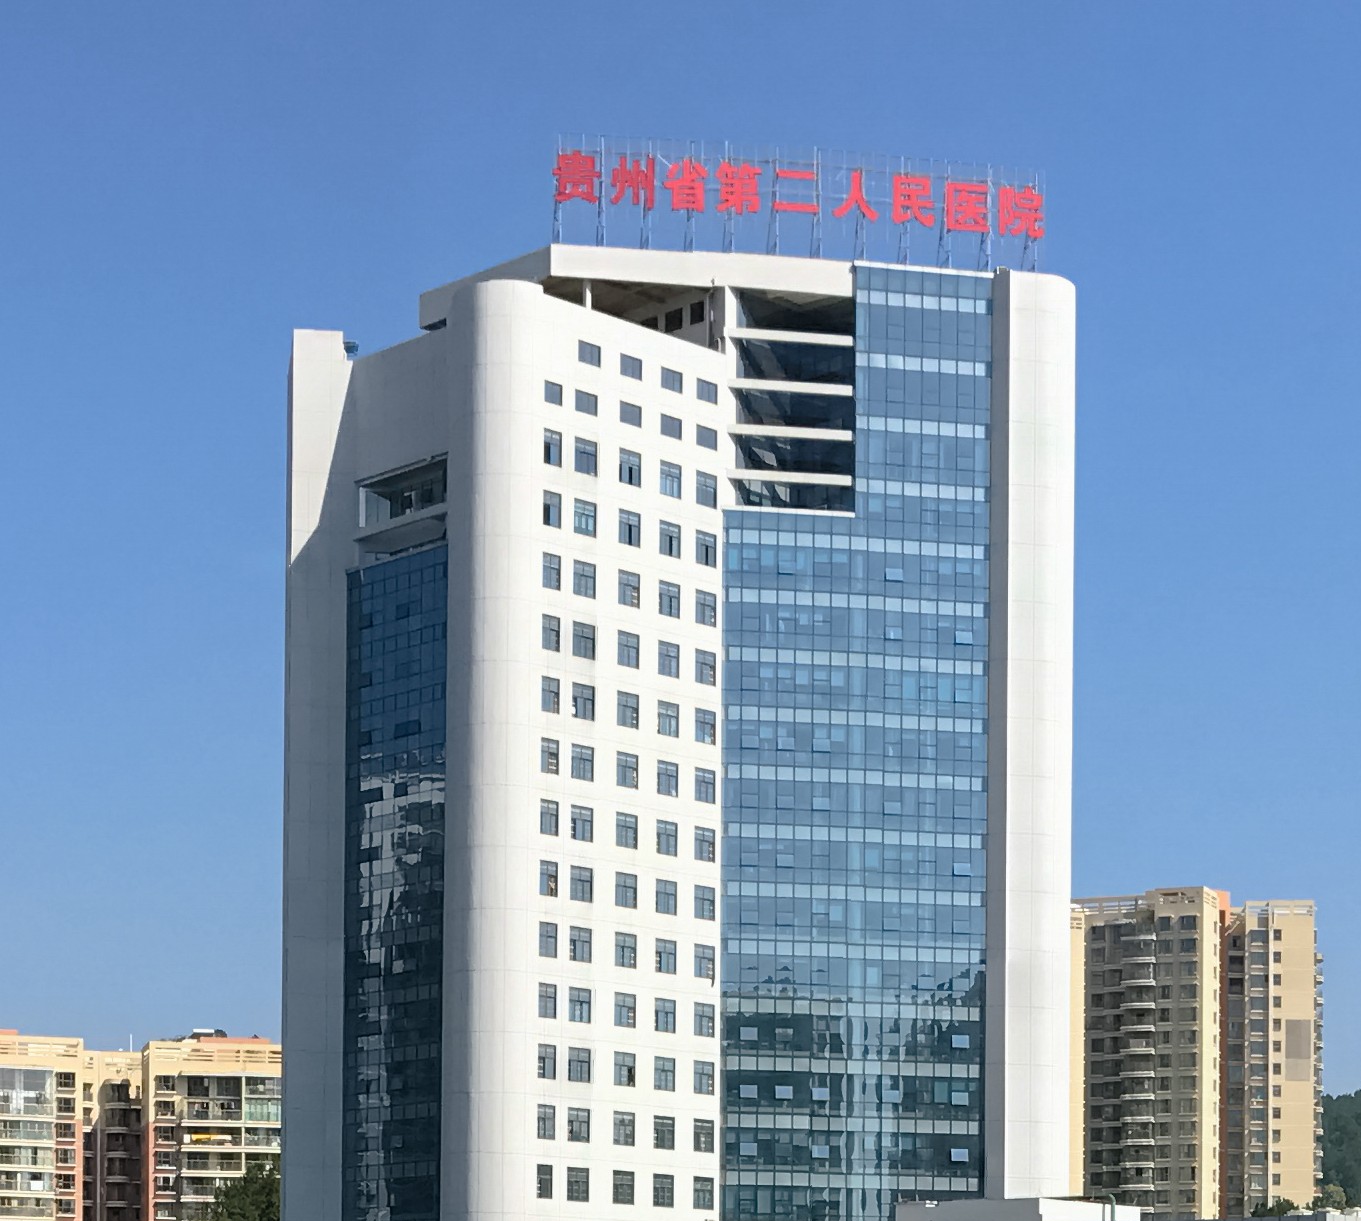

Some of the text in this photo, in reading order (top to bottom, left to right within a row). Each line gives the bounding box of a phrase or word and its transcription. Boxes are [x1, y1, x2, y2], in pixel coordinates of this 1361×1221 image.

[553, 150, 1044, 239] 贵州省第二人民医院
